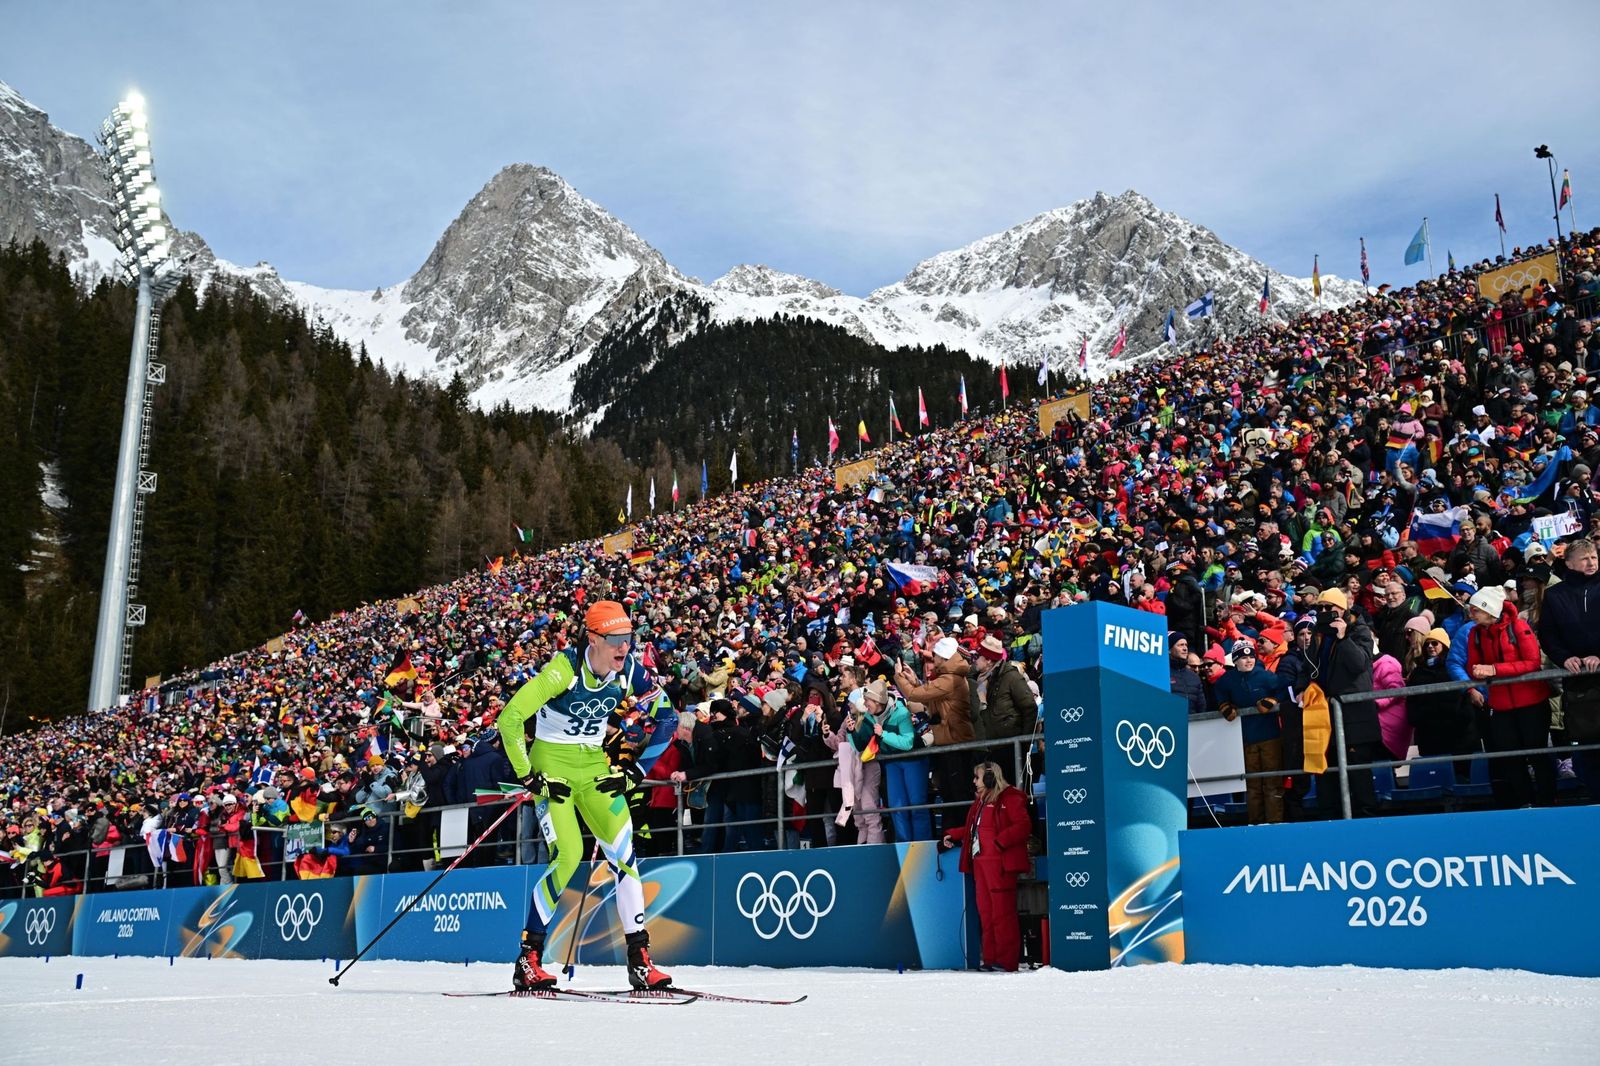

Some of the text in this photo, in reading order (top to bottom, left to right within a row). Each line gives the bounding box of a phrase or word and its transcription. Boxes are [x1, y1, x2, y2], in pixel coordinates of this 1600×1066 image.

[601, 616, 631, 628] SLOVEN
[1104, 623, 1164, 656] FINISH
[563, 718, 602, 737] 35
[1222, 853, 1577, 894] MILANO CORTINA
[394, 891, 507, 913] MILANO CORTINA
[1347, 896, 1428, 927] 2026
[96, 907, 161, 923] MILANO CORTINA
[434, 914, 461, 933] 2026
[117, 923, 134, 938] 2026
